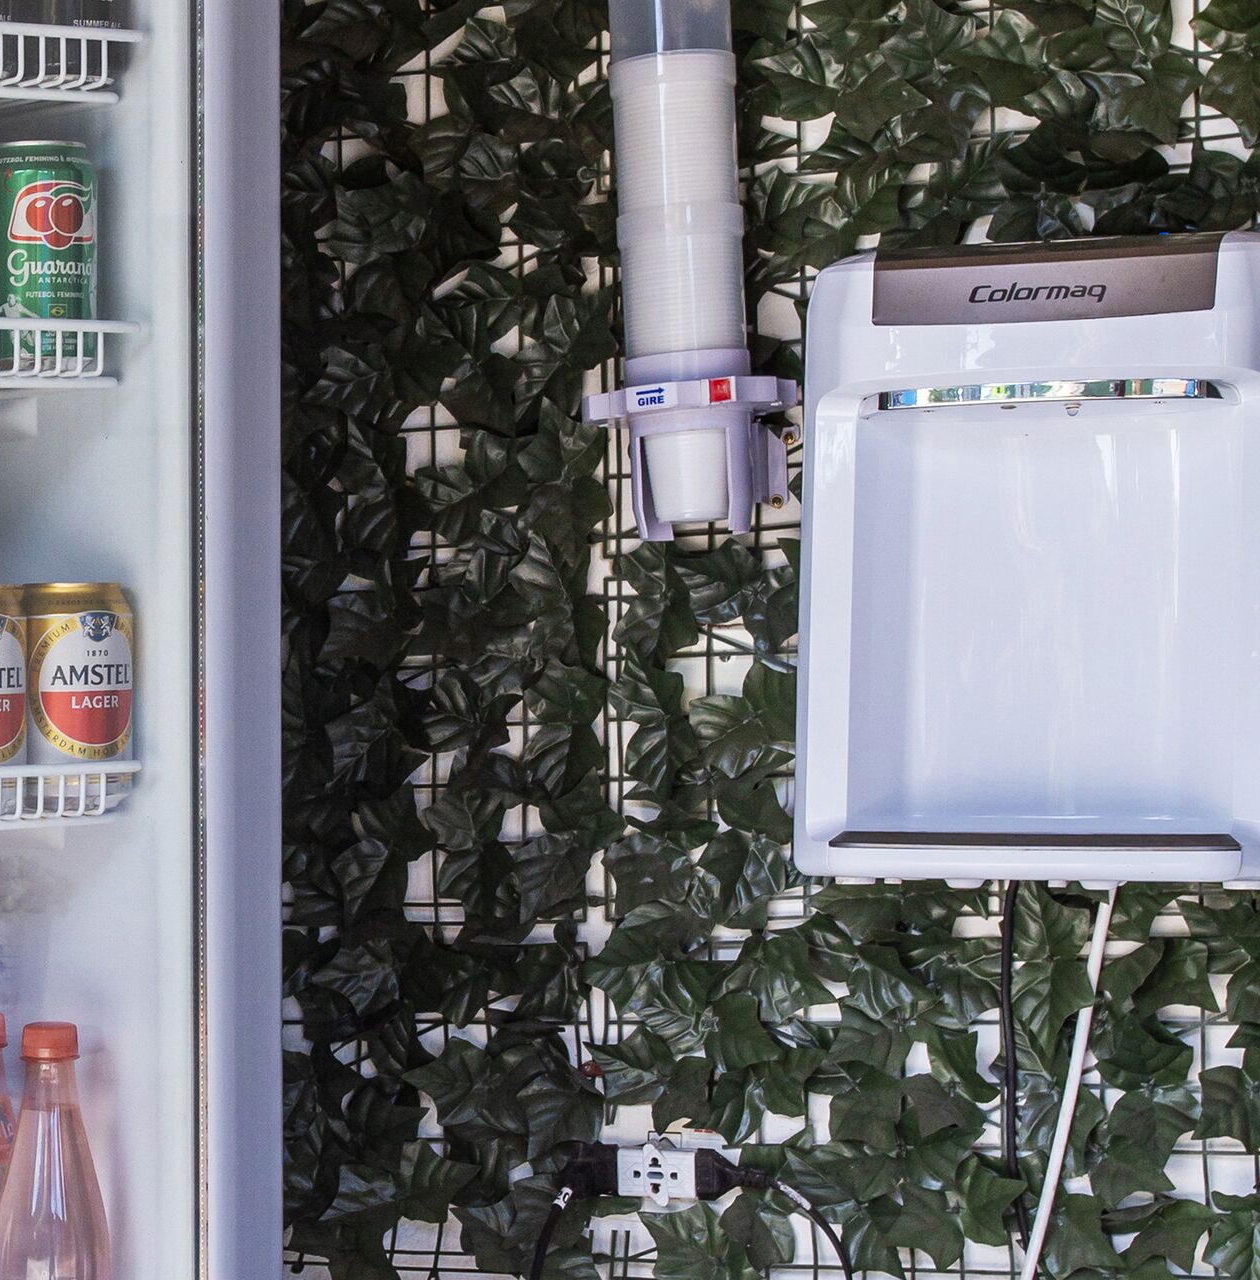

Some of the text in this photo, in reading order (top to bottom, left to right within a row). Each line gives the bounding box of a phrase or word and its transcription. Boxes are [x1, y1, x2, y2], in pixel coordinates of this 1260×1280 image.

[7, 248, 93, 287] Guaraná
[968, 281, 1107, 304] Colormaq
[638, 396, 665, 407] GIRE
[86, 649, 109, 658] 1870
[50, 664, 131, 687] AMSTEL
[71, 695, 120, 710] LAGER
